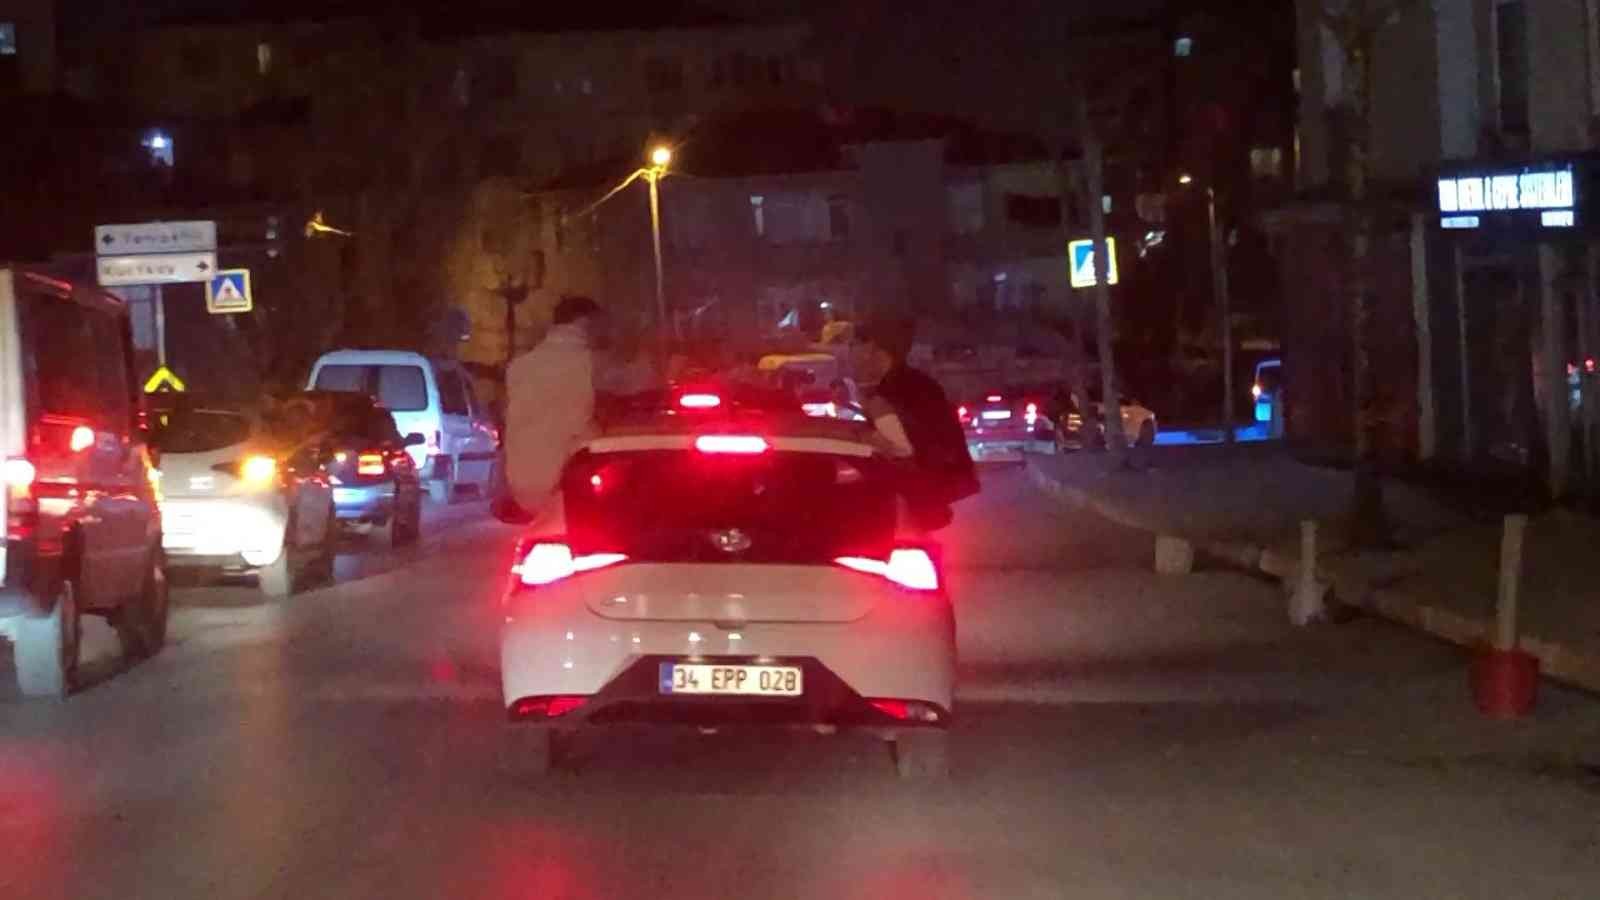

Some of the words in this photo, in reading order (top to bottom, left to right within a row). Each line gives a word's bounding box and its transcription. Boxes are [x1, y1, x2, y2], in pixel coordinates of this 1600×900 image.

[675, 668, 699, 689] 34
[711, 668, 748, 690] EPP
[759, 670, 796, 691] 028
